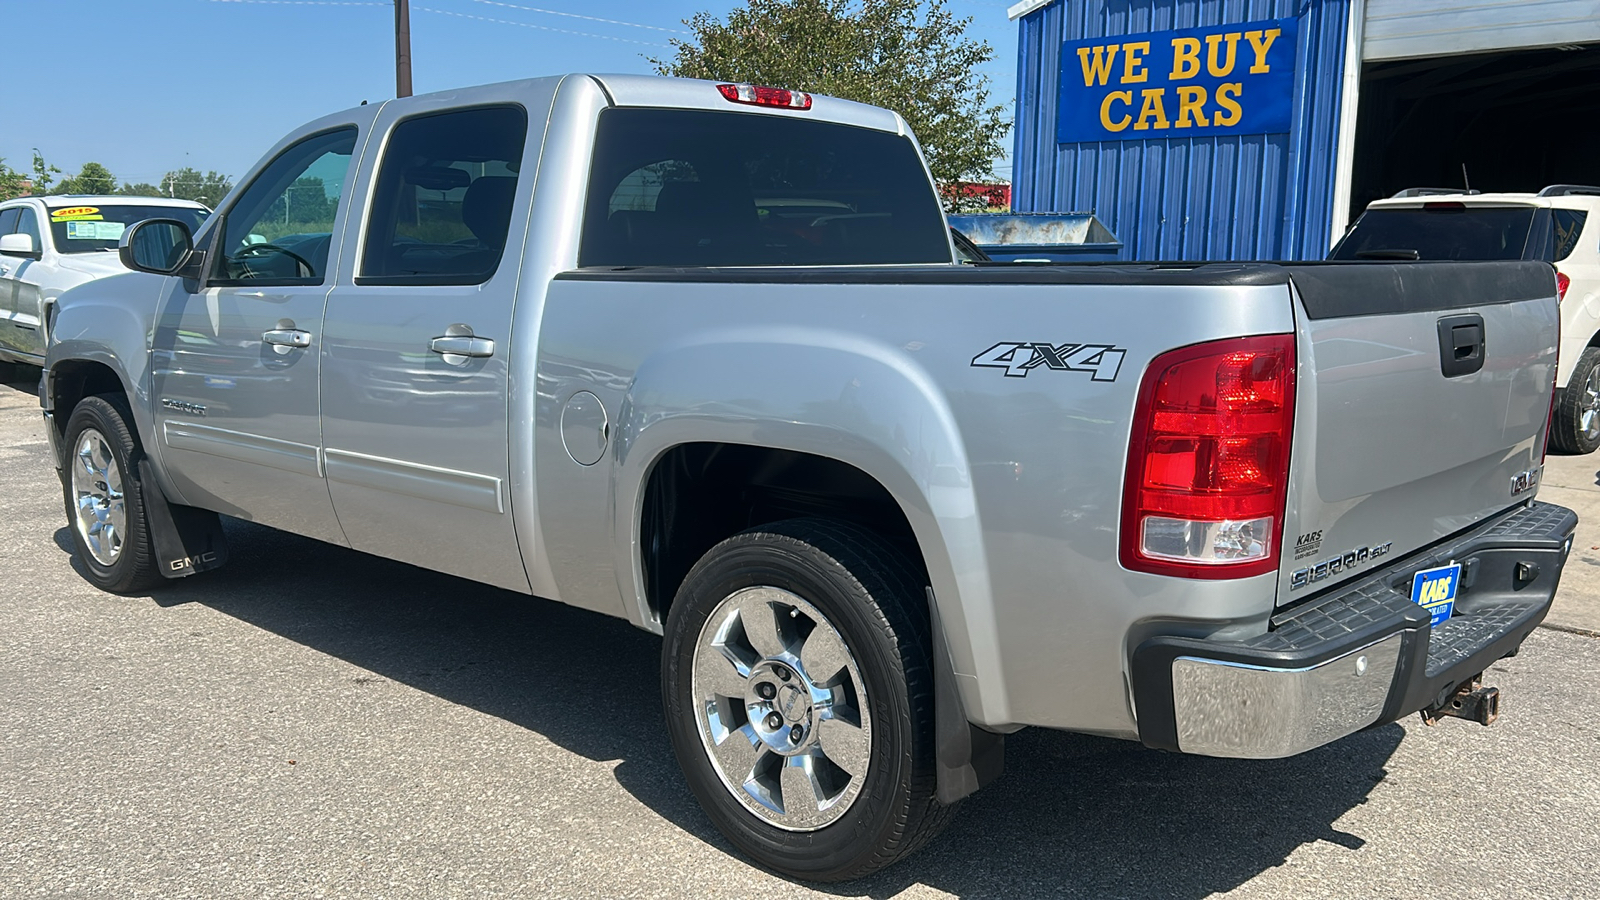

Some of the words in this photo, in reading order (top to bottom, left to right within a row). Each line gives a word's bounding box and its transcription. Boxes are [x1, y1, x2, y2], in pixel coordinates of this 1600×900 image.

[1077, 41, 1150, 87] WE
[1169, 28, 1281, 80] BUY
[1100, 83, 1243, 132] CARS
[58, 208, 93, 216] 2015
[1510, 470, 1538, 494] GMC
[1296, 530, 1323, 546] KARS
[170, 551, 217, 570] GMC
[1290, 547, 1368, 591] SIERRA
[1369, 541, 1393, 560] SLT
[1418, 576, 1452, 606] KARS
